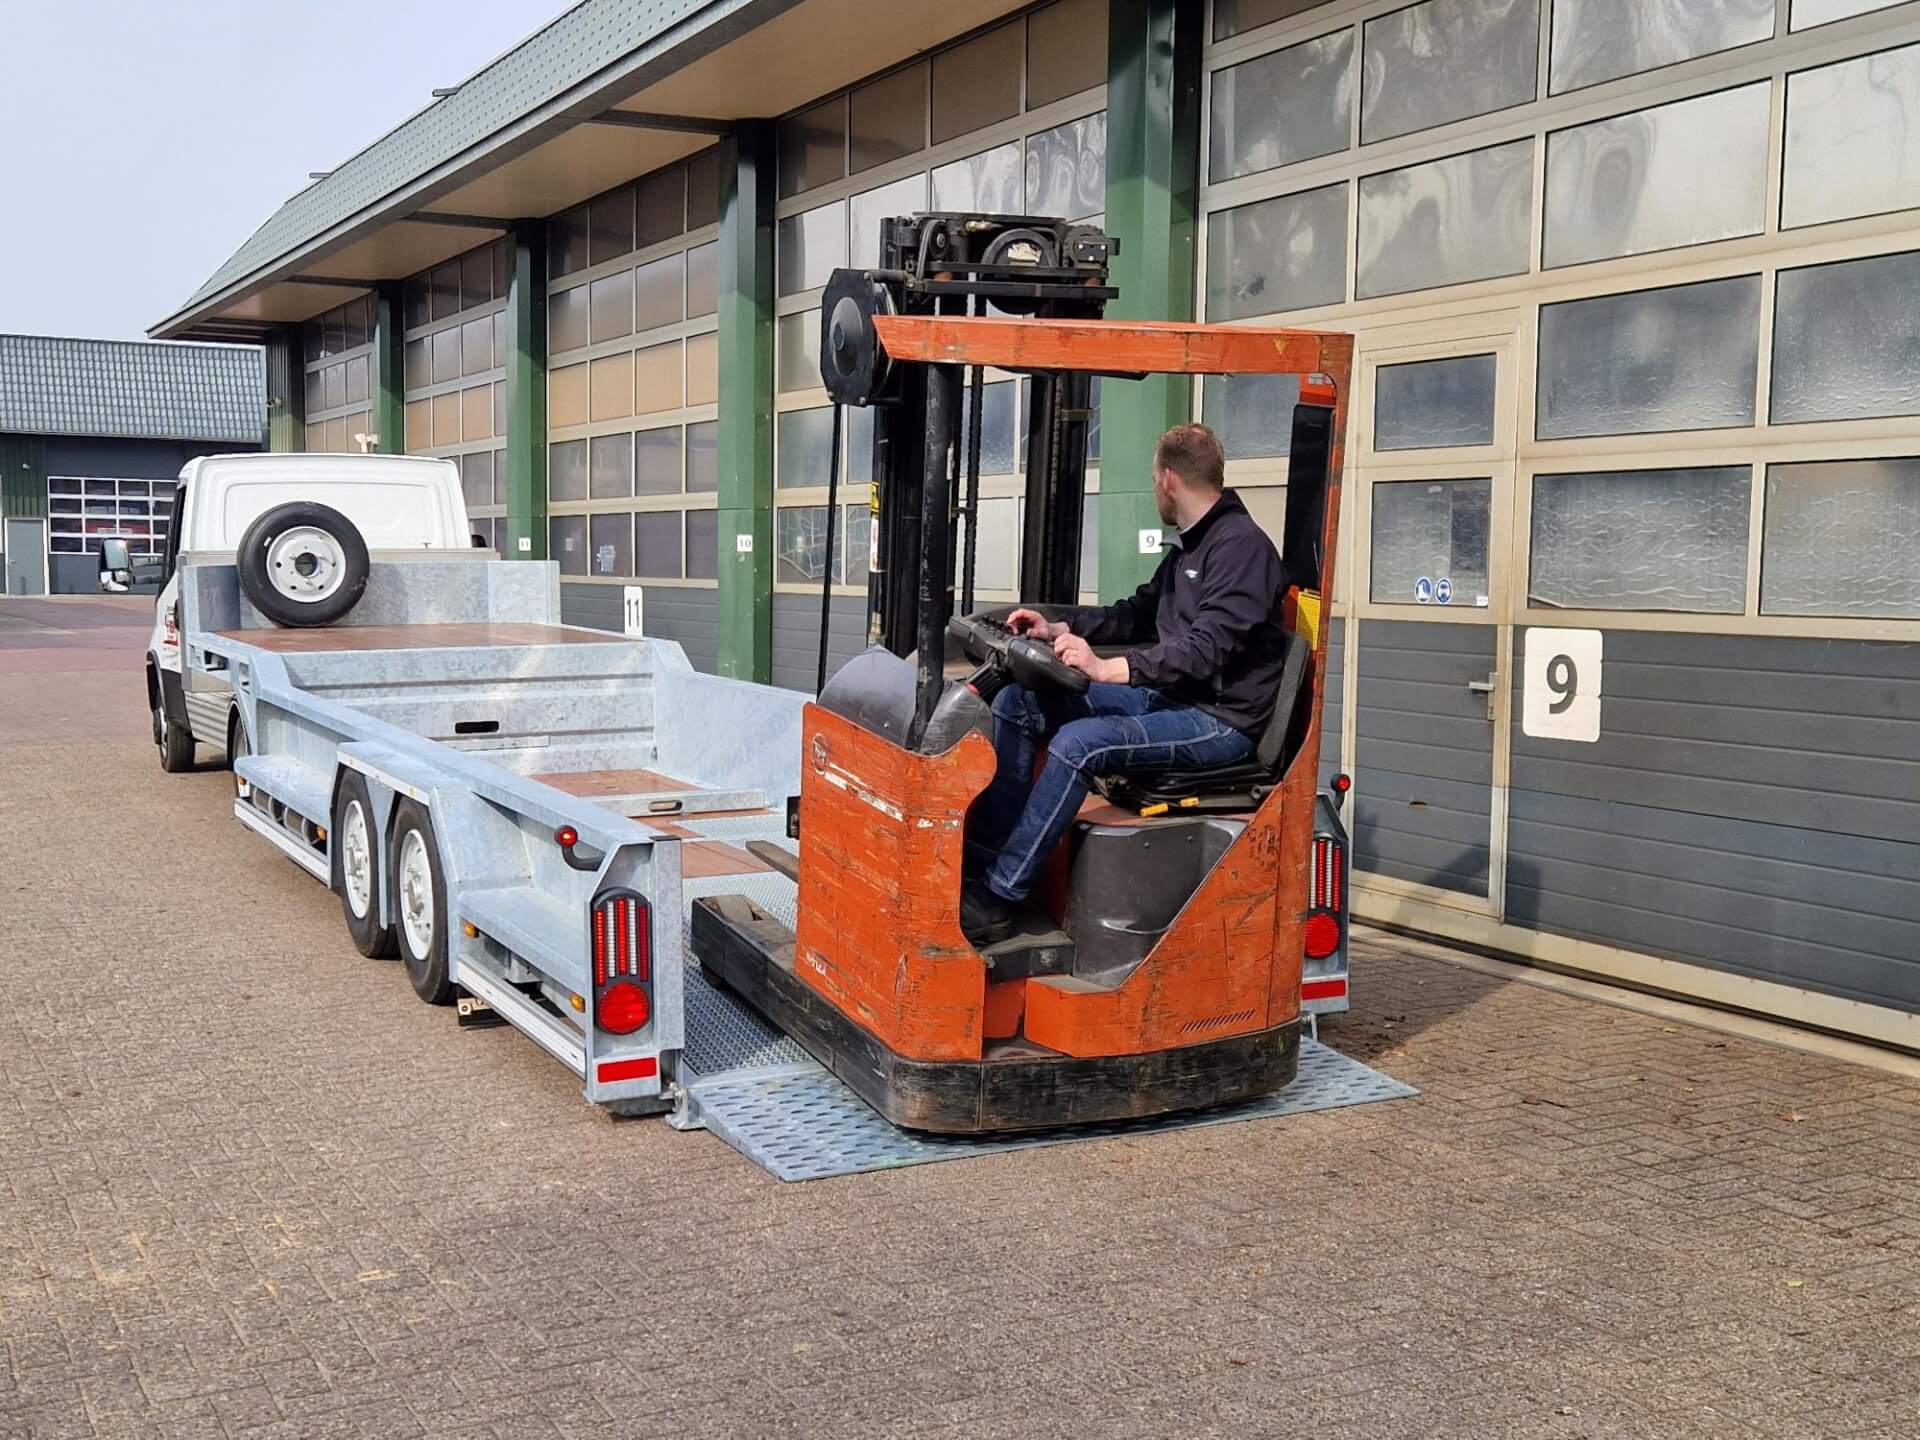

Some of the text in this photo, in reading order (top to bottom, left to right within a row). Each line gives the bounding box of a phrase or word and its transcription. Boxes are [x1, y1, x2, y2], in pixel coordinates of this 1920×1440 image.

[740, 538, 751, 547] 10
[1146, 535, 1155, 547] 9
[626, 598, 640, 627] 11
[1546, 654, 1578, 714] 9
